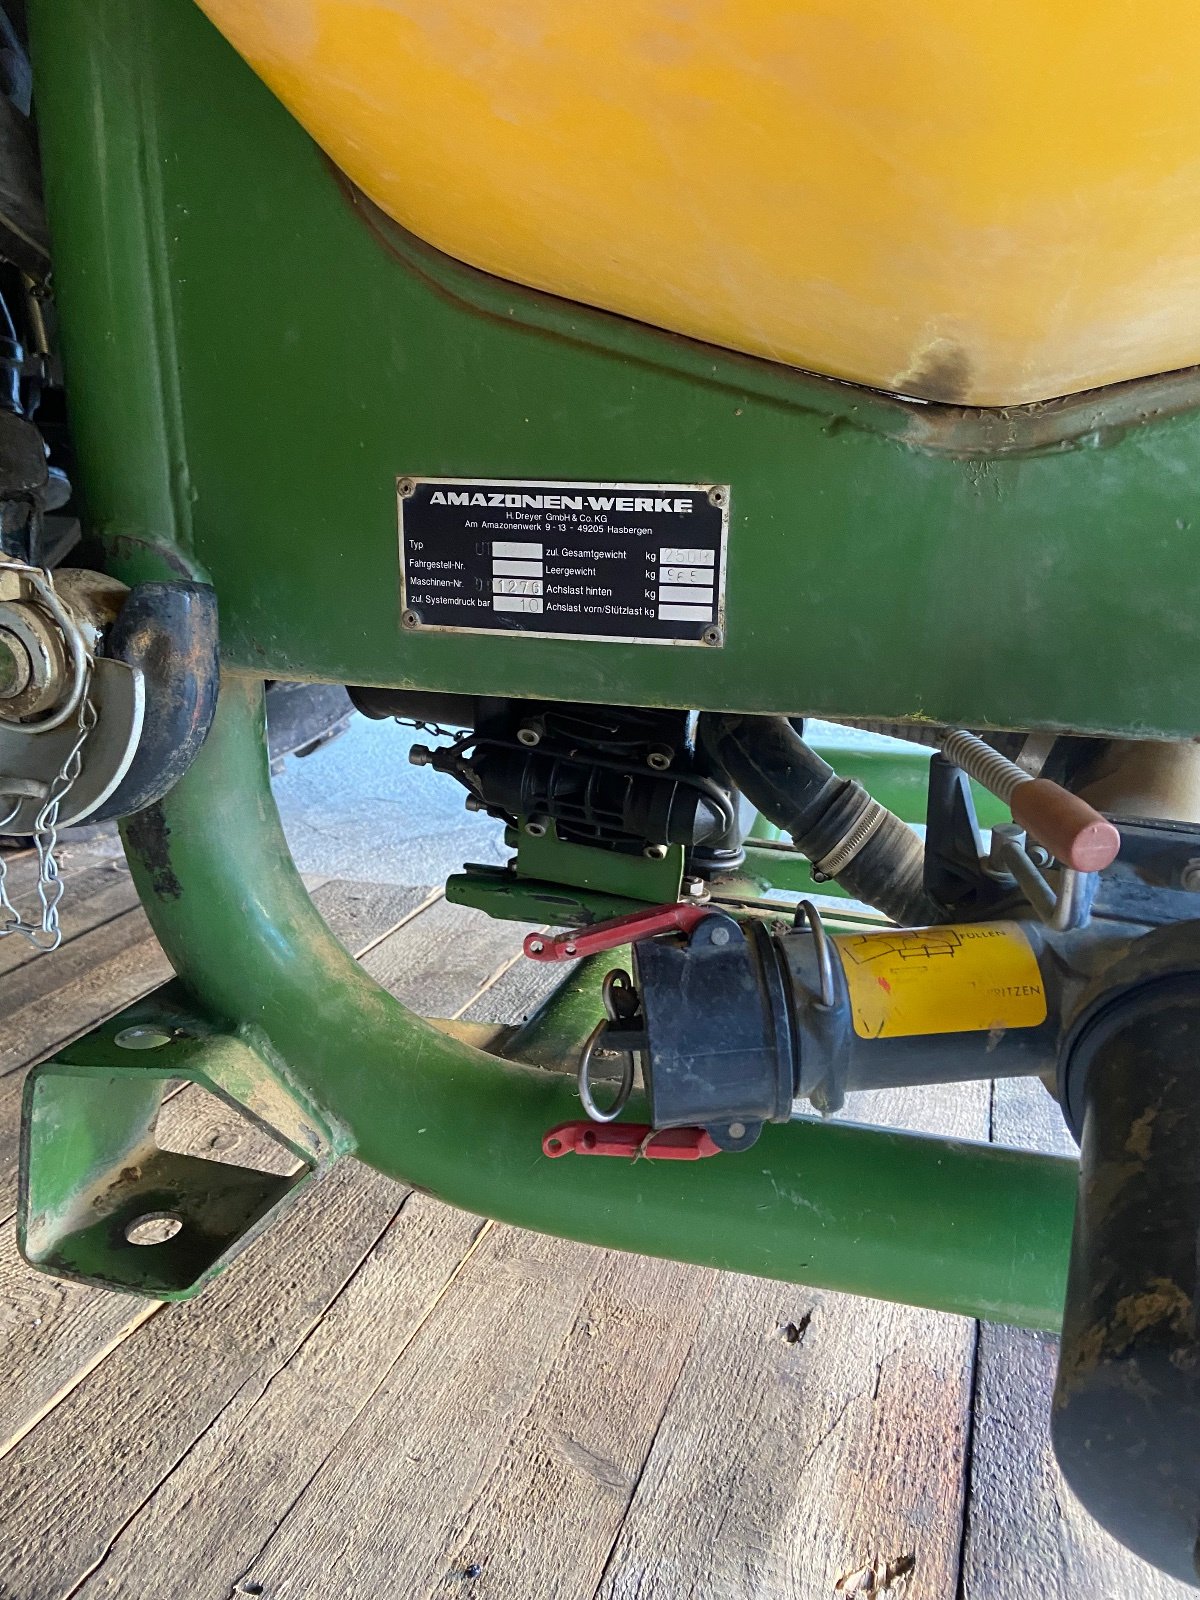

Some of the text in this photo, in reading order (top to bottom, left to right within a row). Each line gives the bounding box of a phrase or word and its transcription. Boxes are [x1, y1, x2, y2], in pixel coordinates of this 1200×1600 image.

[430, 491, 693, 513] AMAZONEN-WERKE
[515, 512, 542, 521] Dreyer
[546, 513, 571, 522] GmbH
[572, 514, 578, 522] &
[579, 514, 592, 522] Co.
[594, 515, 608, 523] KG
[465, 520, 478, 528] Am
[481, 521, 542, 531] Amazonenwerk
[577, 525, 604, 533] 49205
[607, 526, 653, 536] Hasbergen
[409, 540, 424, 551] Typ
[561, 548, 627, 560] Gesamtgewicht
[646, 551, 656, 562] kg
[409, 559, 466, 570] Fahrgestell-Nr.
[546, 565, 596, 576] Leergewicht
[646, 570, 656, 580] kg
[410, 577, 464, 588] Maschinen-Nr.
[546, 584, 656, 600] Achslast hinten kg
[426, 595, 476, 606] Systemdruck
[478, 598, 491, 607] bar
[520, 599, 538, 612] 10
[546, 602, 655, 618] Achslast vorn/Stützlast kg
